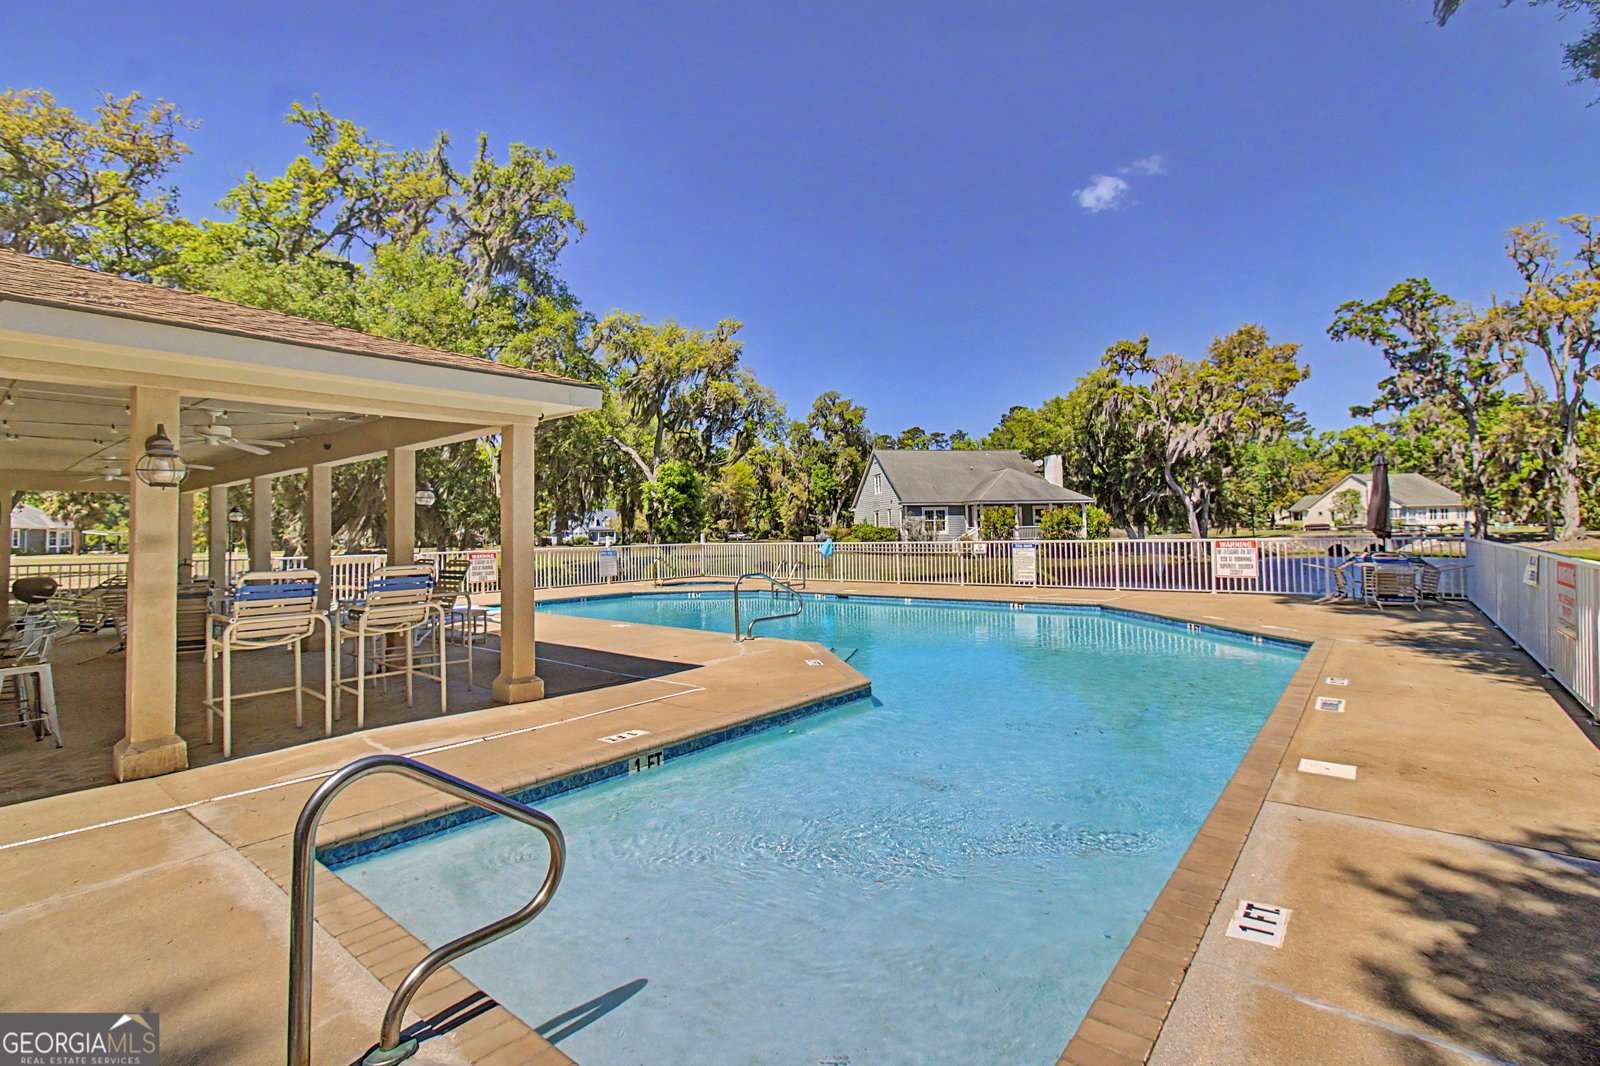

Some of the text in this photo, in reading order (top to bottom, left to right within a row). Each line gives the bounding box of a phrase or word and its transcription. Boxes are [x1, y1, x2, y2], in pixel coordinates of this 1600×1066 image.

[634, 751, 663, 772] 1 FT
[1238, 903, 1281, 936] 1 FT
